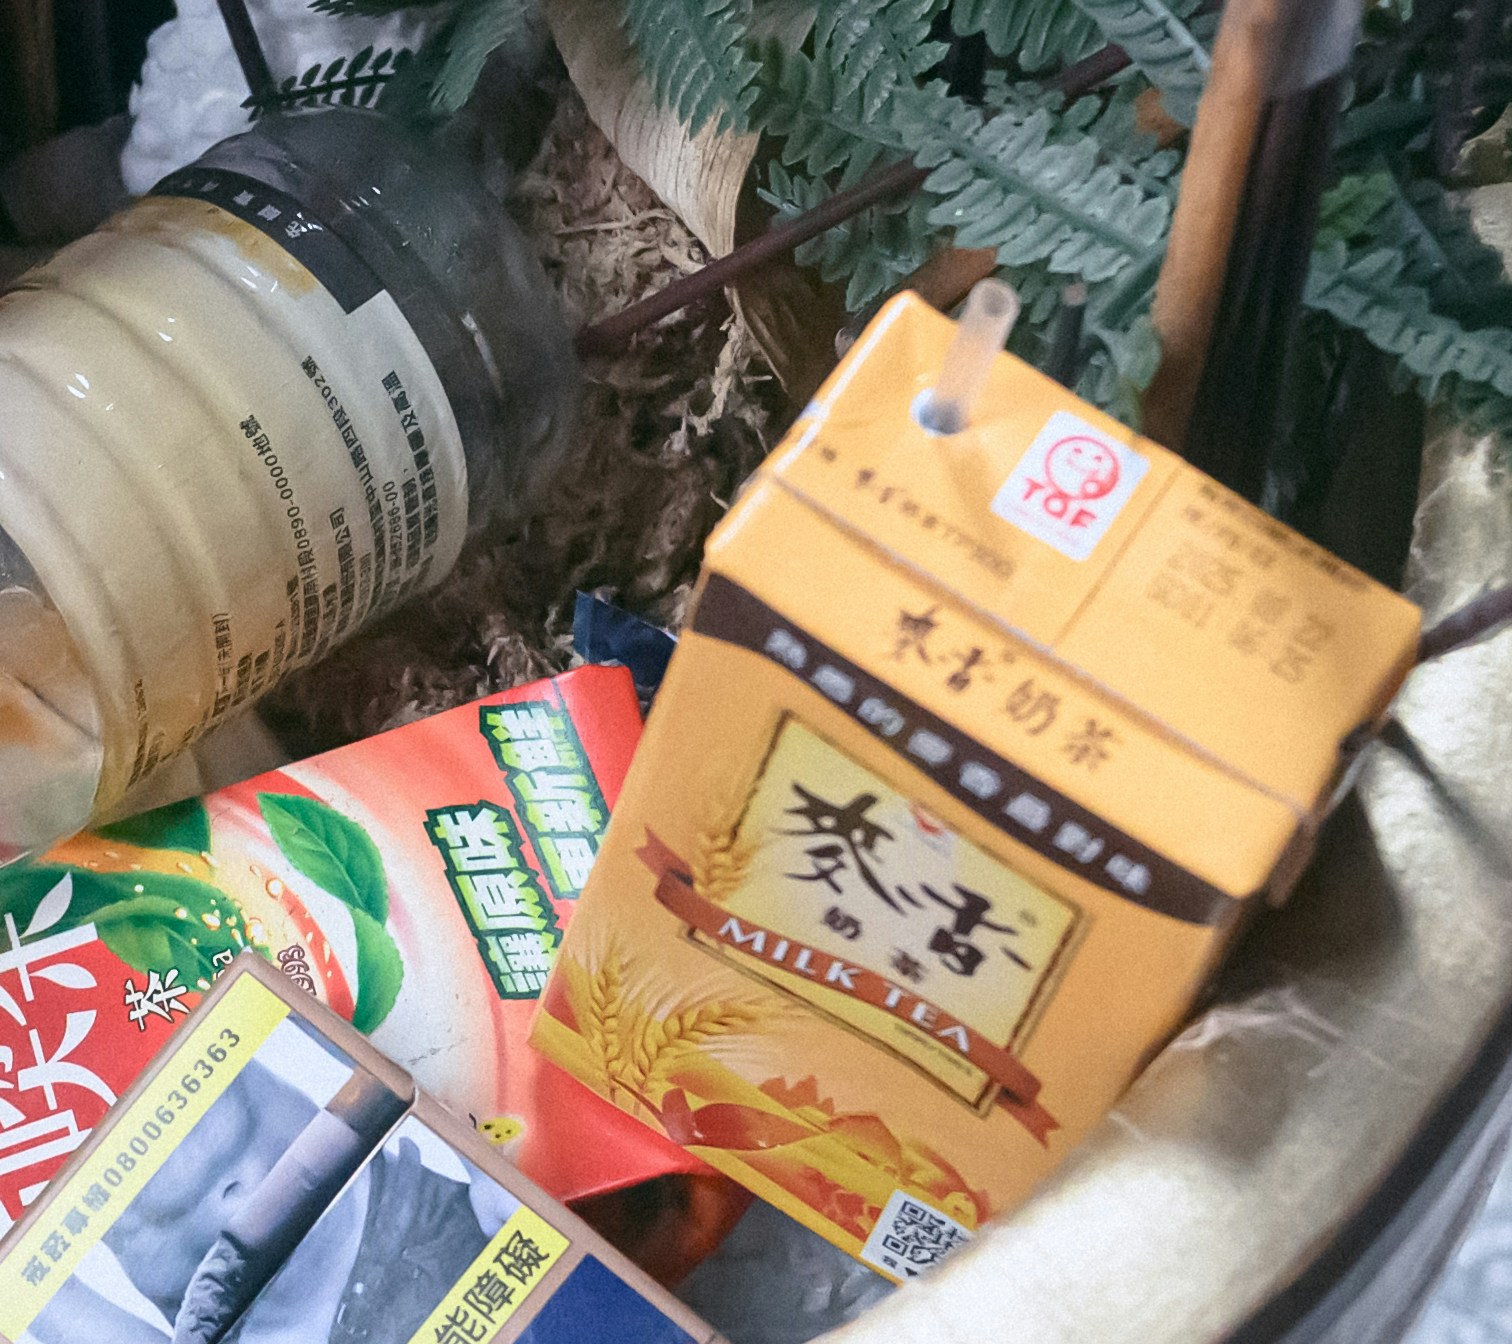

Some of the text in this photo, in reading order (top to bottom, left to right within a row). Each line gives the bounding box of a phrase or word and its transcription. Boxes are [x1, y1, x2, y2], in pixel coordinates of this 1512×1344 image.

[1022, 477, 1097, 527] TQF
[893, 604, 1120, 770] 麥香奶茶
[431, 805, 559, 995] 讓原味
[771, 782, 1032, 977] 麥香
[719, 918, 859, 989] MILK
[883, 981, 970, 1052] TEA
